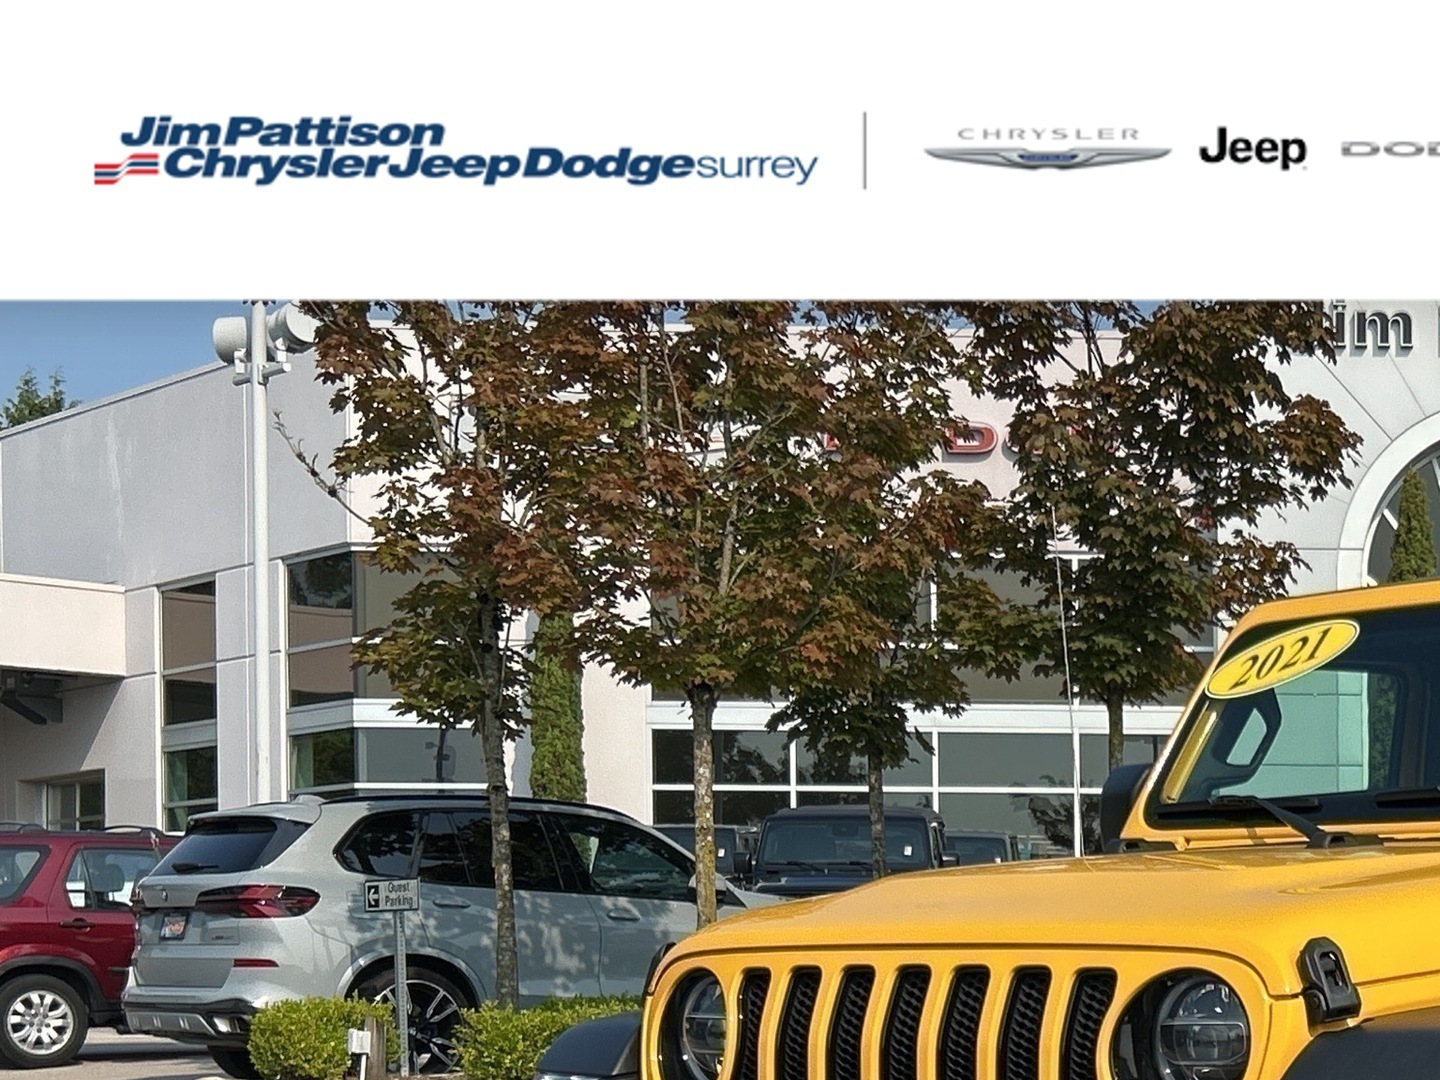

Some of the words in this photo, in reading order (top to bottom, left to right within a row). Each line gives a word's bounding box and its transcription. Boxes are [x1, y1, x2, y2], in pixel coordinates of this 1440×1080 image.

[1330, 301, 1414, 349] im
[1228, 626, 1333, 691] 2021
[385, 896, 413, 908] Parking
[387, 882, 410, 893] Guest
